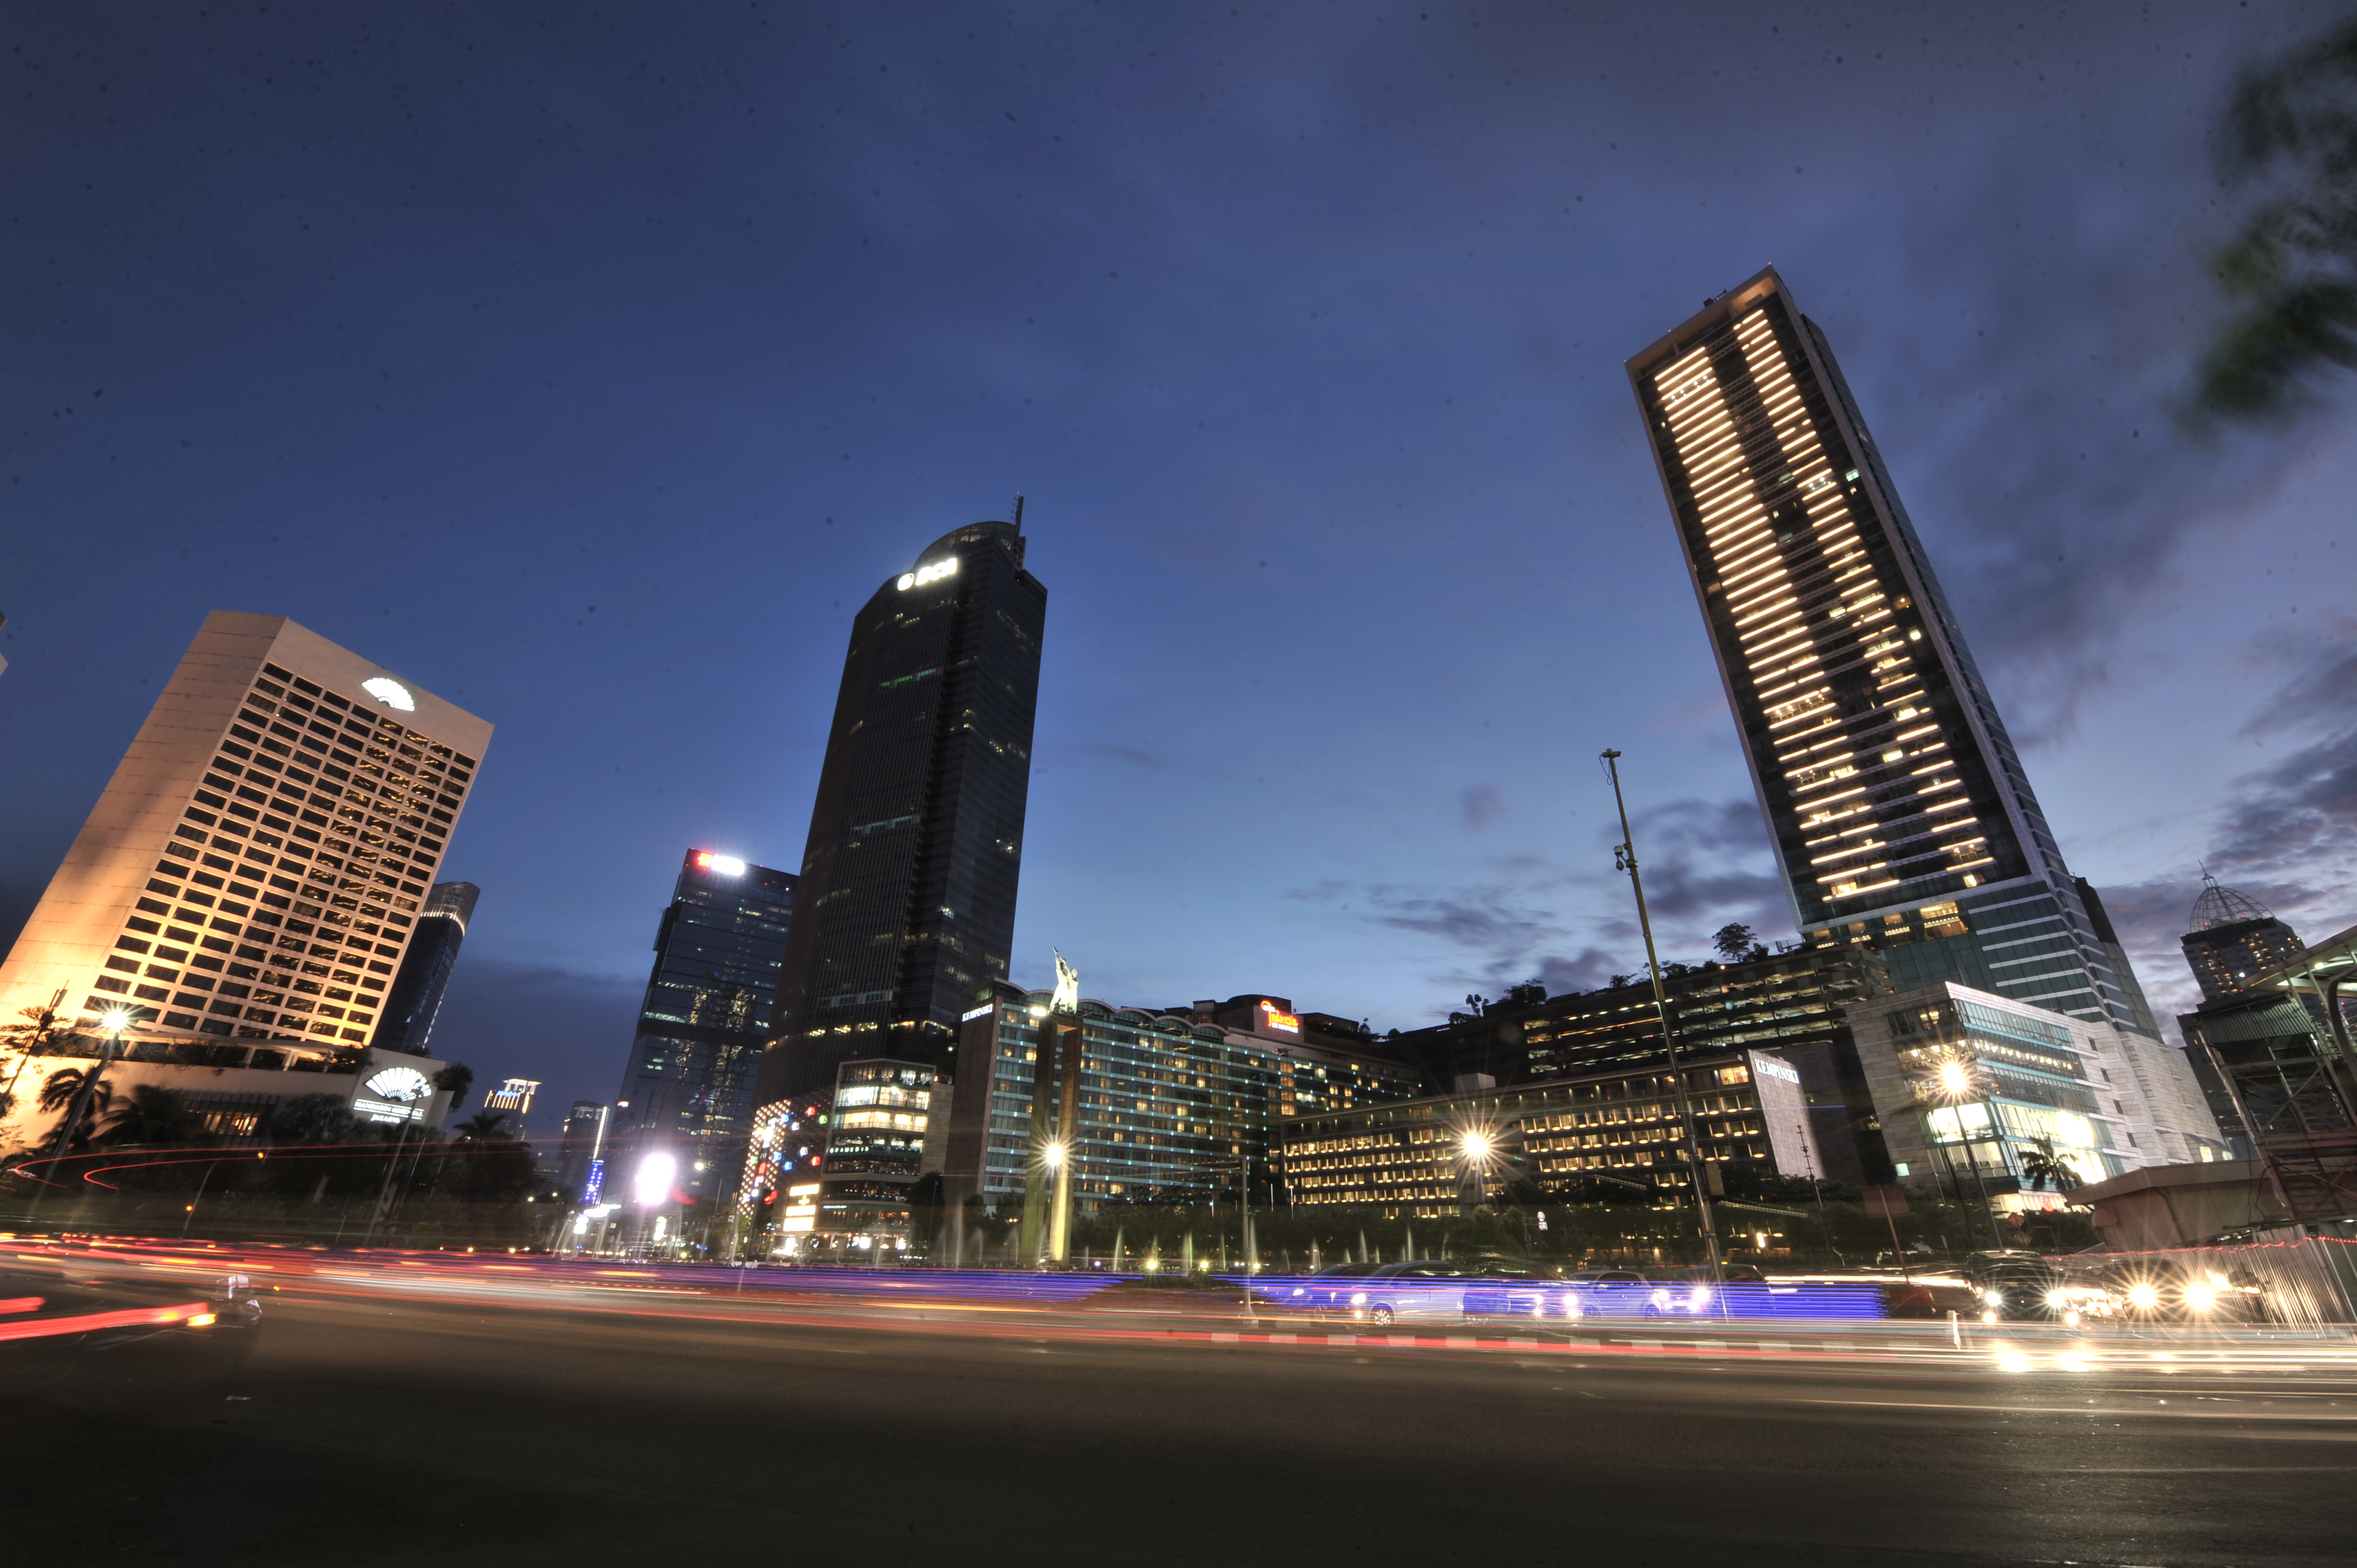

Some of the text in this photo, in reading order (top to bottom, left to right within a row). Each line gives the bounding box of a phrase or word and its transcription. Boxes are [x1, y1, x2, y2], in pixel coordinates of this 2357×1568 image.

[962, 1003, 993, 1022] KEMPINSKI
[1754, 1058, 1800, 1084] KEMPINSKI
[354, 1101, 392, 1112] MANDARIN
